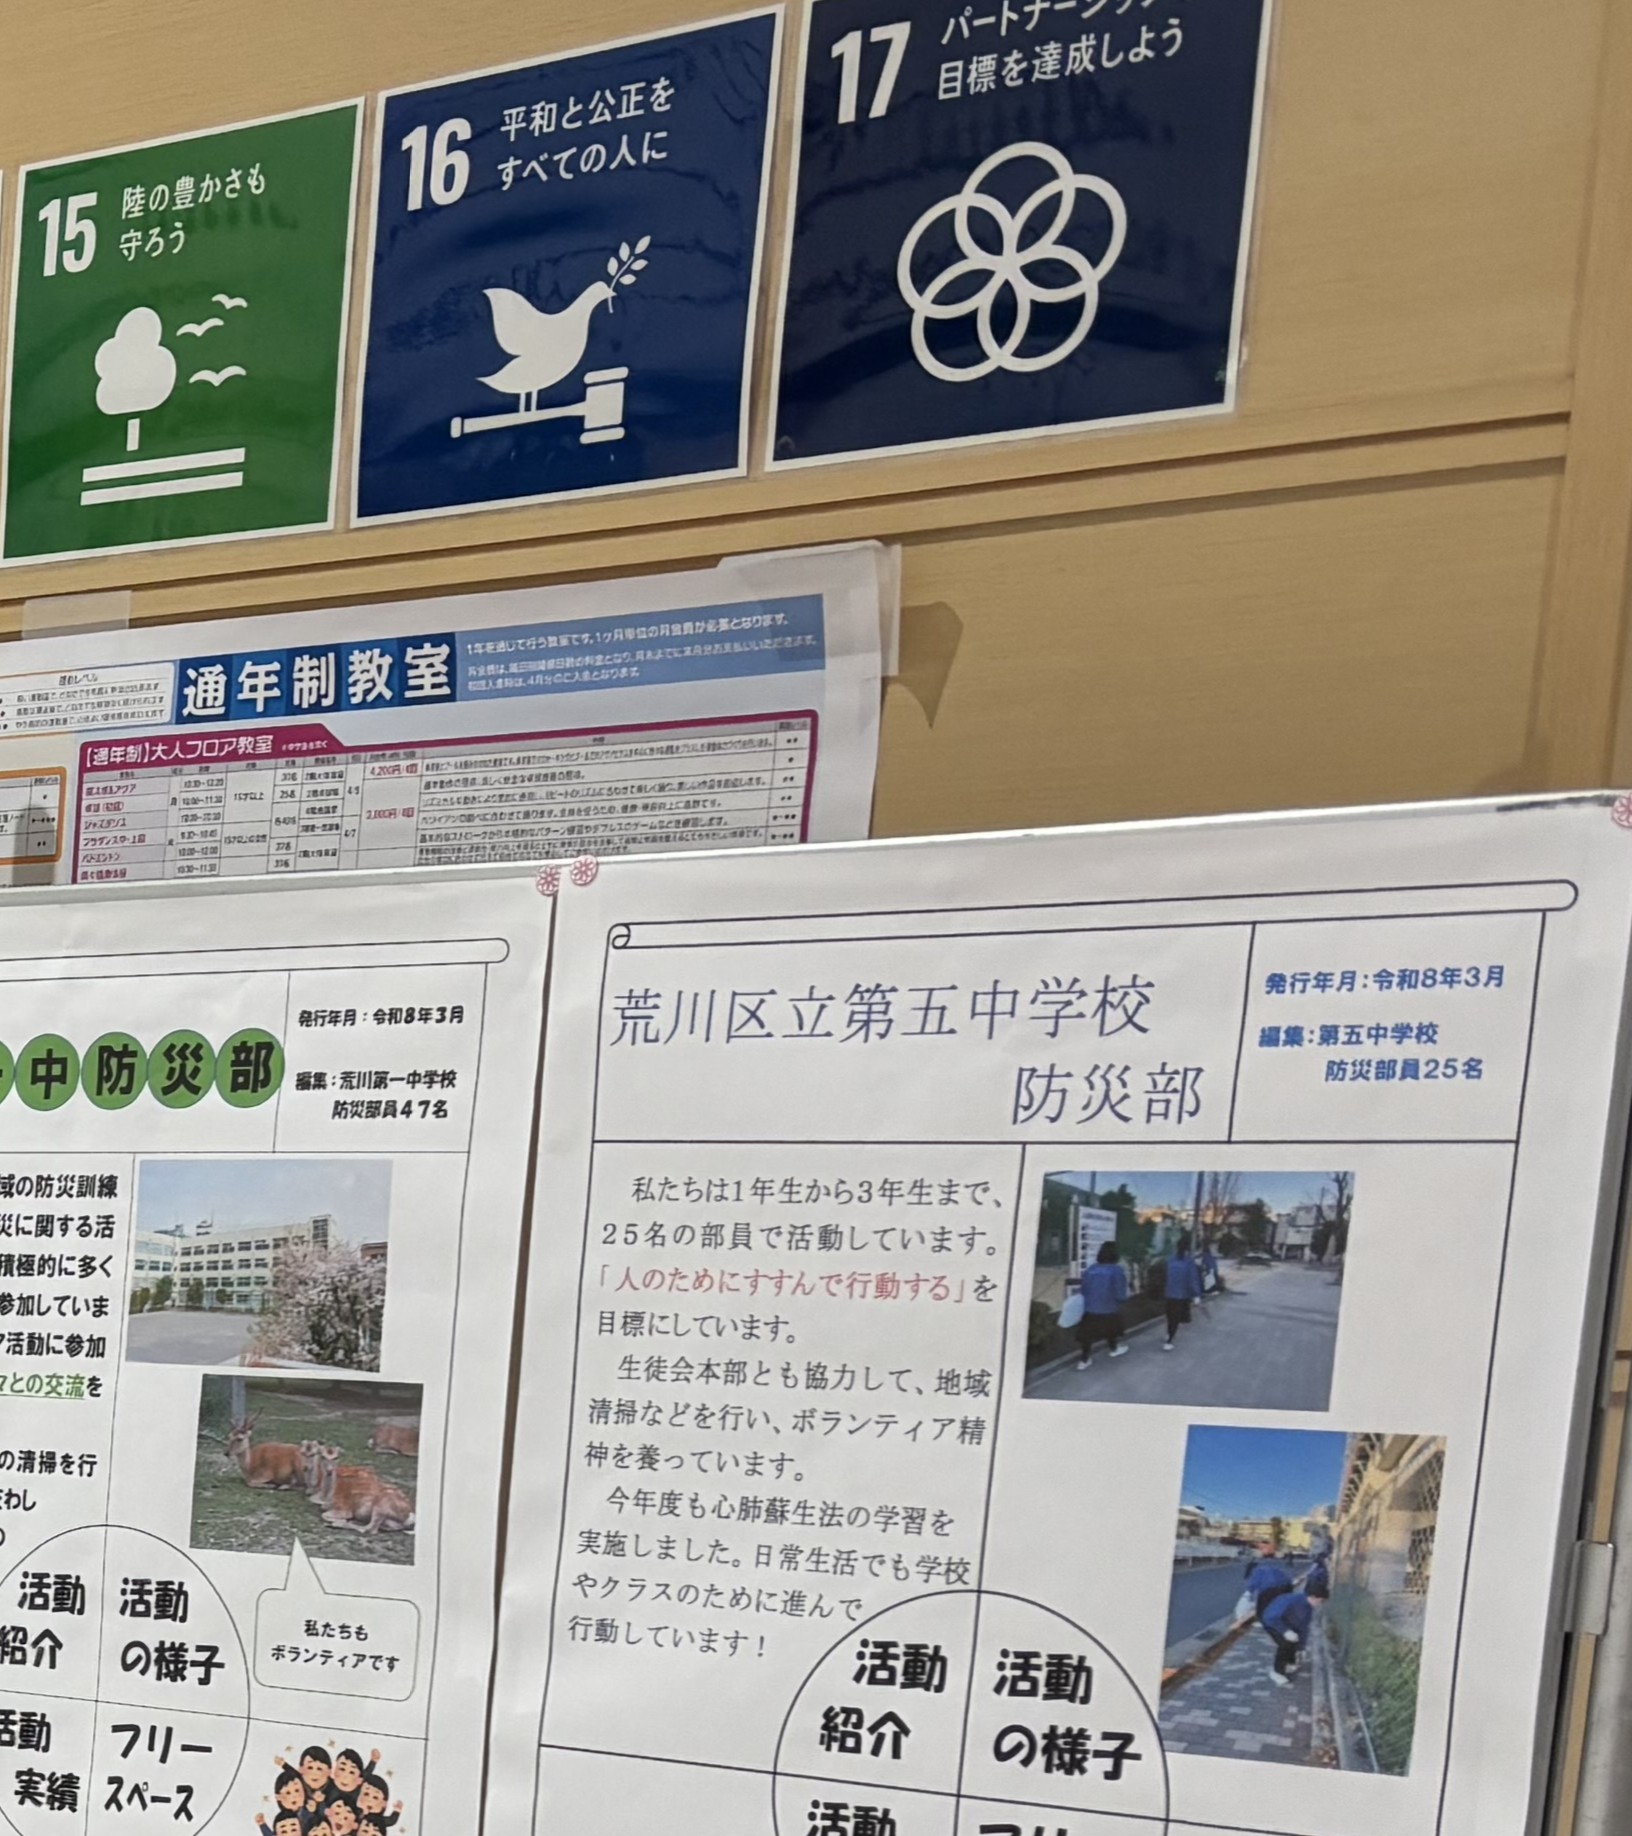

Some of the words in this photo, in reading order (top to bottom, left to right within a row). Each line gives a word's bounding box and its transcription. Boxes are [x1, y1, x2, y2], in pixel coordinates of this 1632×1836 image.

[831, 21, 911, 126] 17
[936, 19, 1186, 102] 目標を達成しよう
[498, 76, 676, 141] 平和と公正を
[401, 116, 471, 212] 16
[496, 130, 670, 191] すべての人に
[121, 163, 266, 220] 陸の豊かさも
[39, 191, 99, 277] 15
[119, 222, 187, 262] 守ろう
[182, 641, 452, 721] 通年制教室
[85, 734, 274, 767] 【通年制】大人フロア教室
[1264, 962, 1506, 996] 発行年月：令和8年3月
[298, 1005, 465, 1029] 発行年月：令和8年3月
[609, 974, 1158, 1048] 荒川区立第五中学校
[1257, 1021, 1440, 1051] 編集：第五中学校
[295, 1069, 458, 1092] 編集：荒川第一中学校
[1324, 1056, 1484, 1084] 防災部員25名
[1010, 1061, 1205, 1126] 防災部
[596, 1309, 799, 1344] 目標にしています。
[584, 1441, 808, 1484] 神を養っています。
[17, 1571, 86, 1617] 活動
[119, 1577, 189, 1623] 活動
[304, 1619, 368, 1642] 私たちも
[568, 1615, 769, 1662] 行動しています！
[121, 1643, 226, 1687] の様子
[270, 1644, 400, 1674] ボランティアです
[853, 1638, 948, 1693] 活動
[992, 1647, 1094, 1706] 活動
[110, 1723, 214, 1763] フリー
[819, 1706, 913, 1761] 紹介
[993, 1724, 1143, 1782] の様子
[14, 1767, 81, 1812] 実績
[104, 1774, 195, 1821] スペース
